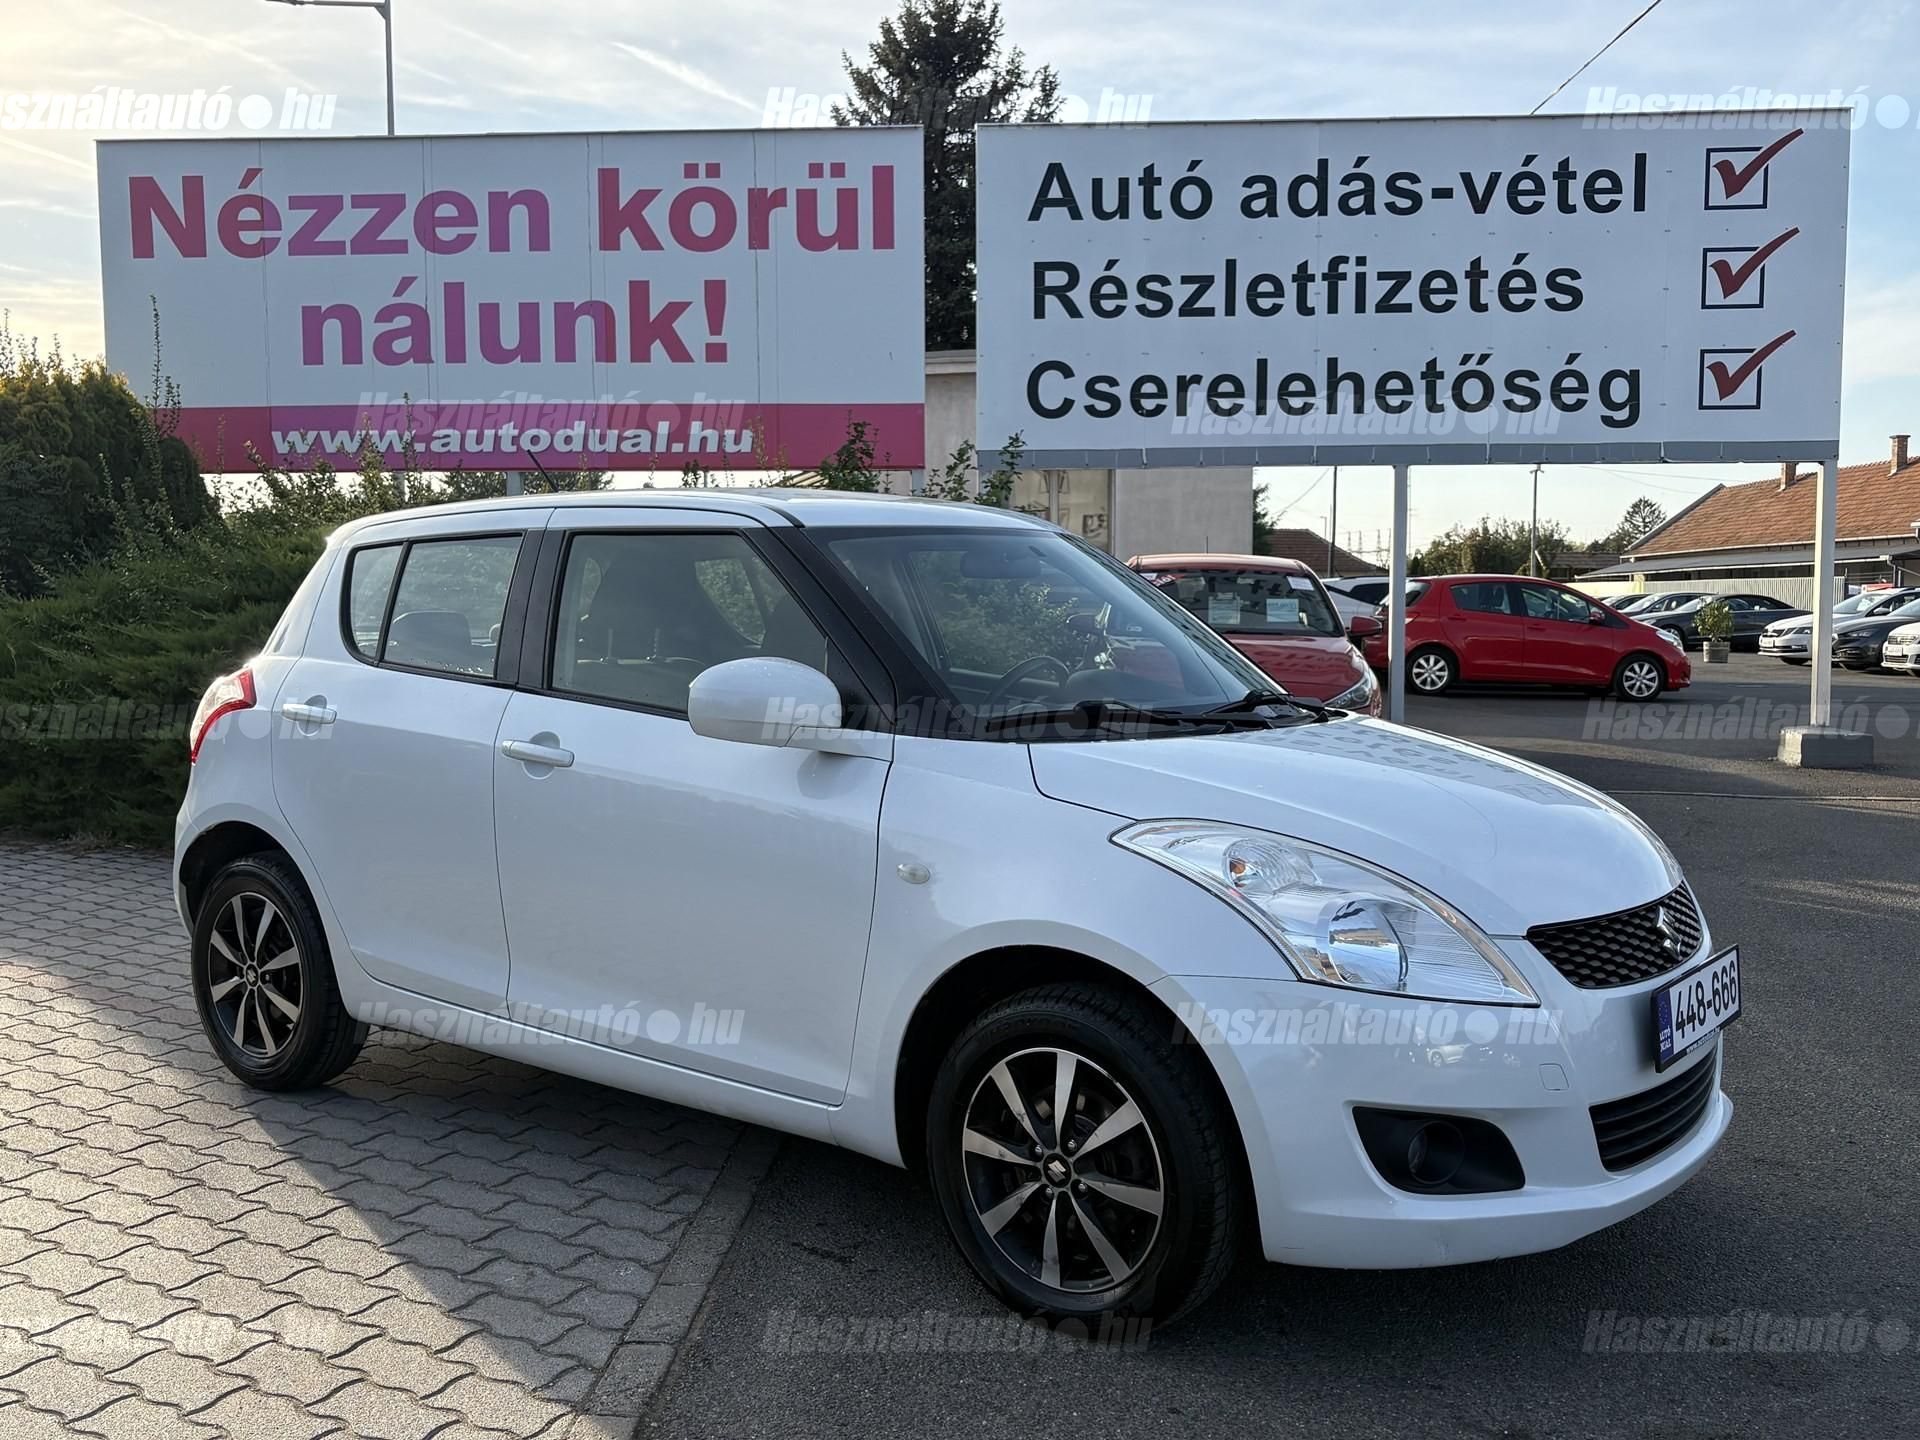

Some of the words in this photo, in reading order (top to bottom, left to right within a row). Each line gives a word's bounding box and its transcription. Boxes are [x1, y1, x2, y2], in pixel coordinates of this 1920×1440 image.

[128, 168, 551, 260] Nézzen
[597, 162, 896, 252] körül
[1027, 159, 1213, 221] Autó
[1240, 152, 1647, 218] adás-vétel
[301, 276, 729, 367] nálunk!
[1033, 252, 1584, 319] Részletfizetés
[1026, 353, 1641, 428] Cserelehetőség
[271, 420, 753, 456] www.autodual.hu
[1675, 960, 1737, 1040] 448-666
